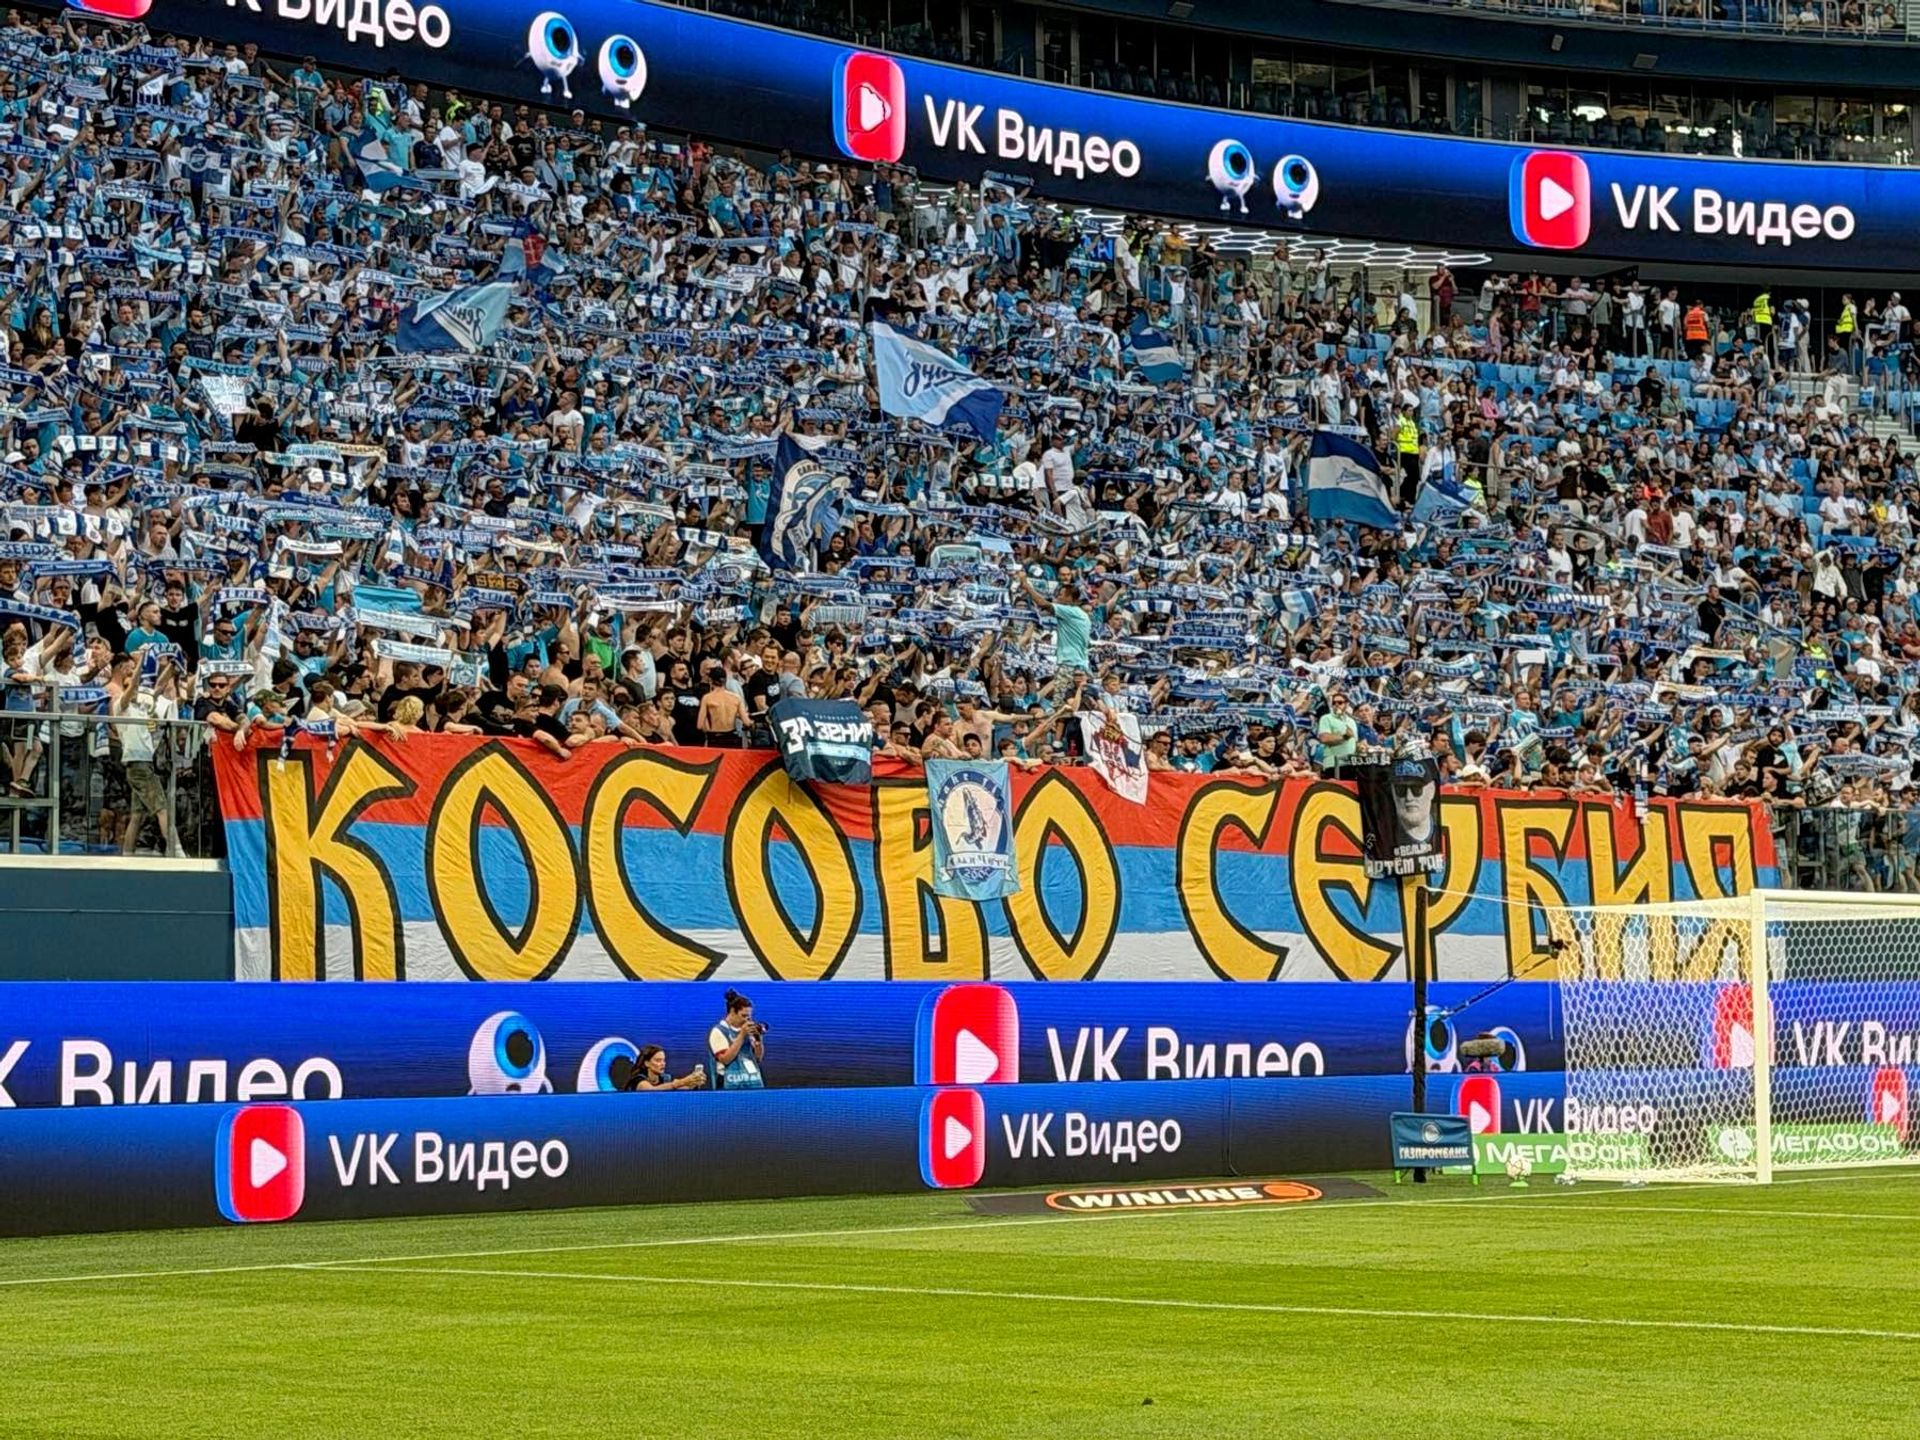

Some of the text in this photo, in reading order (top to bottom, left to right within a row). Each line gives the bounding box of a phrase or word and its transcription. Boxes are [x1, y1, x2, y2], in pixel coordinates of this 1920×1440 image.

[924, 94, 1141, 180] VK Видео
[1611, 182, 1855, 247] VK Видео
[780, 716, 815, 755] ЗА
[257, 739, 1772, 982] КОСОВО СЕРБИЯ
[1047, 1027, 1129, 1083] VK
[1793, 1020, 1920, 1067] VK Ви
[1002, 1112, 1182, 1163] VK Видео
[1513, 1097, 1555, 1135] VK
[328, 1131, 570, 1192] VK Видео
[1399, 1146, 1470, 1161] ГАЗПРОМБАНК
[1070, 1184, 1264, 1210] WINLINE
